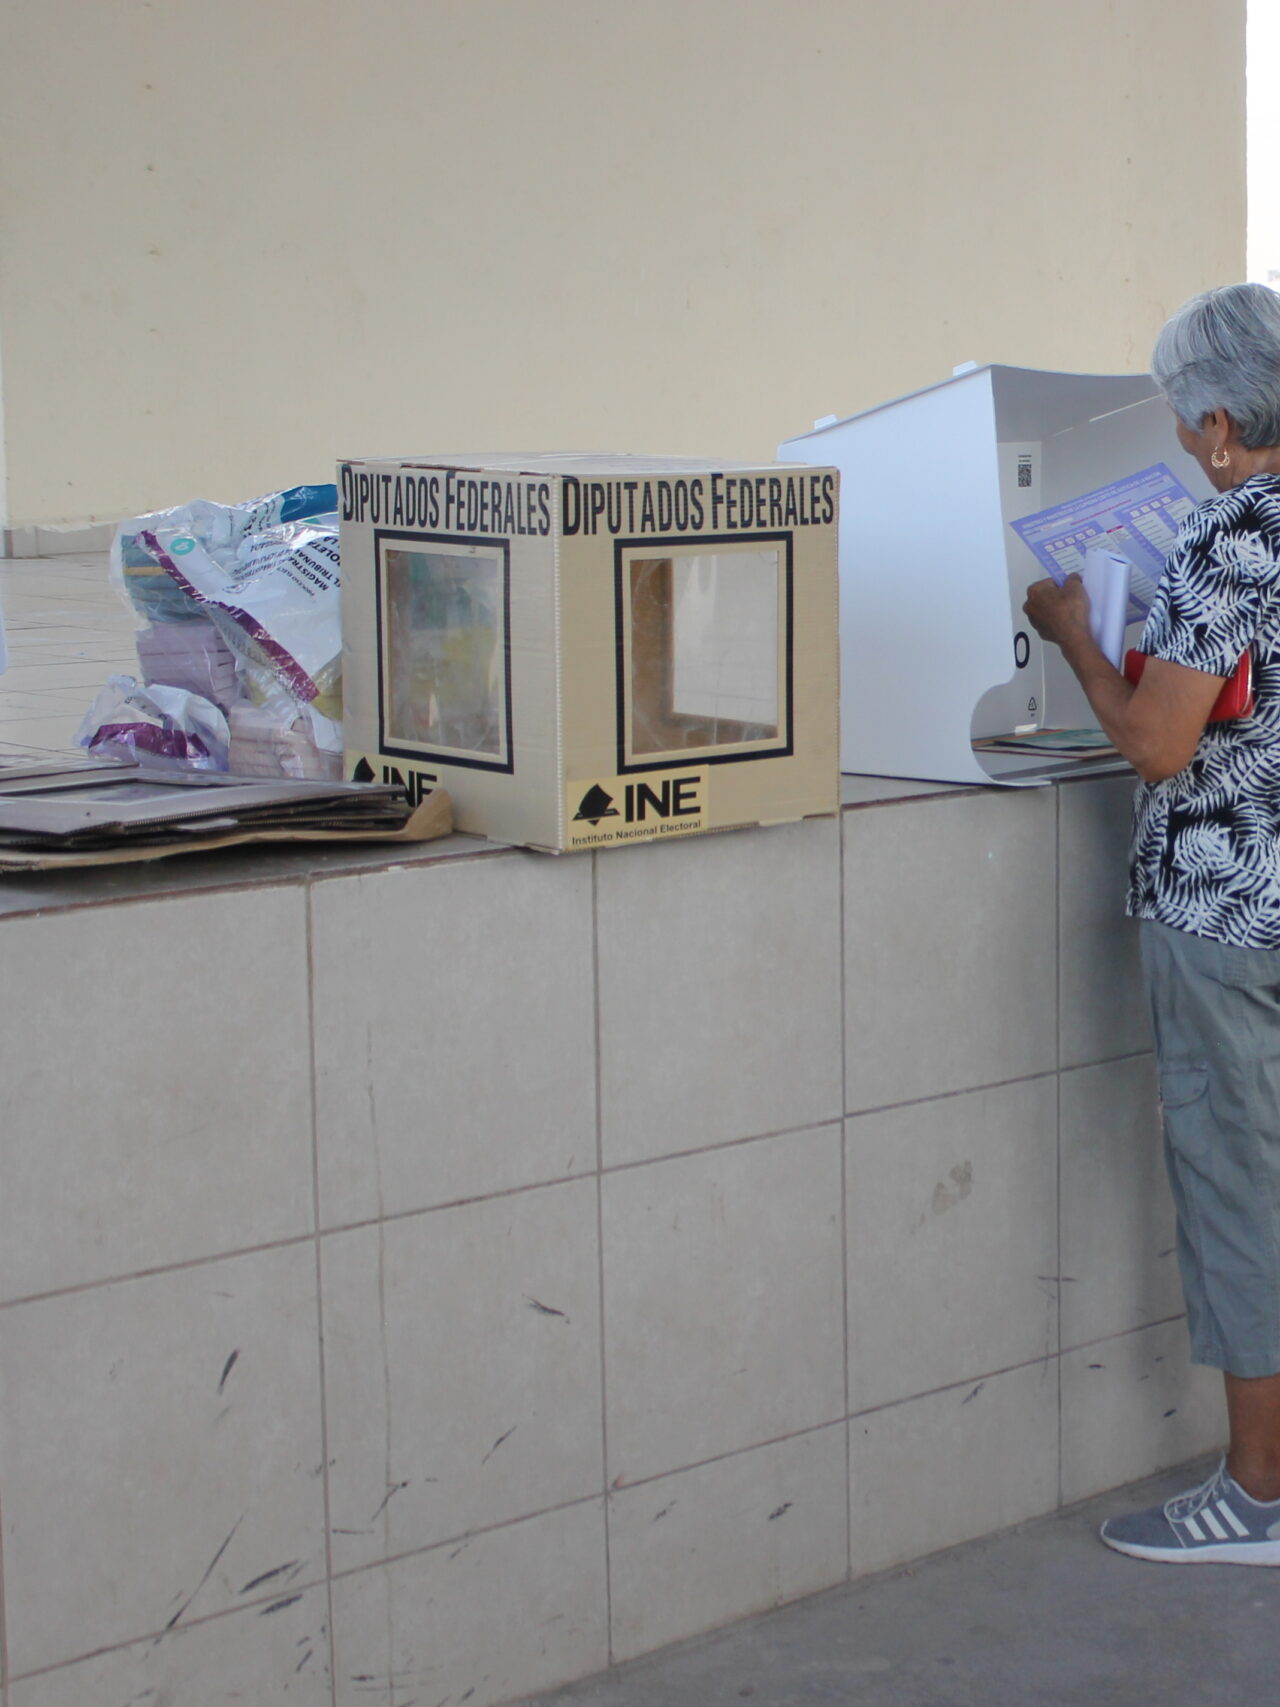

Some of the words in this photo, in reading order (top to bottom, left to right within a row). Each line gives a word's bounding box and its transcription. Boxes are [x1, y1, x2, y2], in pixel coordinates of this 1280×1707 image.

[341, 463, 440, 529] DIPUTADOS
[445, 470, 551, 536] FEDERALES
[561, 475, 705, 536] DIPUTADOS
[711, 472, 834, 530] FEDERALES
[625, 776, 701, 823] INE
[572, 832, 613, 845] Instituto
[616, 823, 657, 839] Nacional
[660, 819, 701, 834] Electoral
